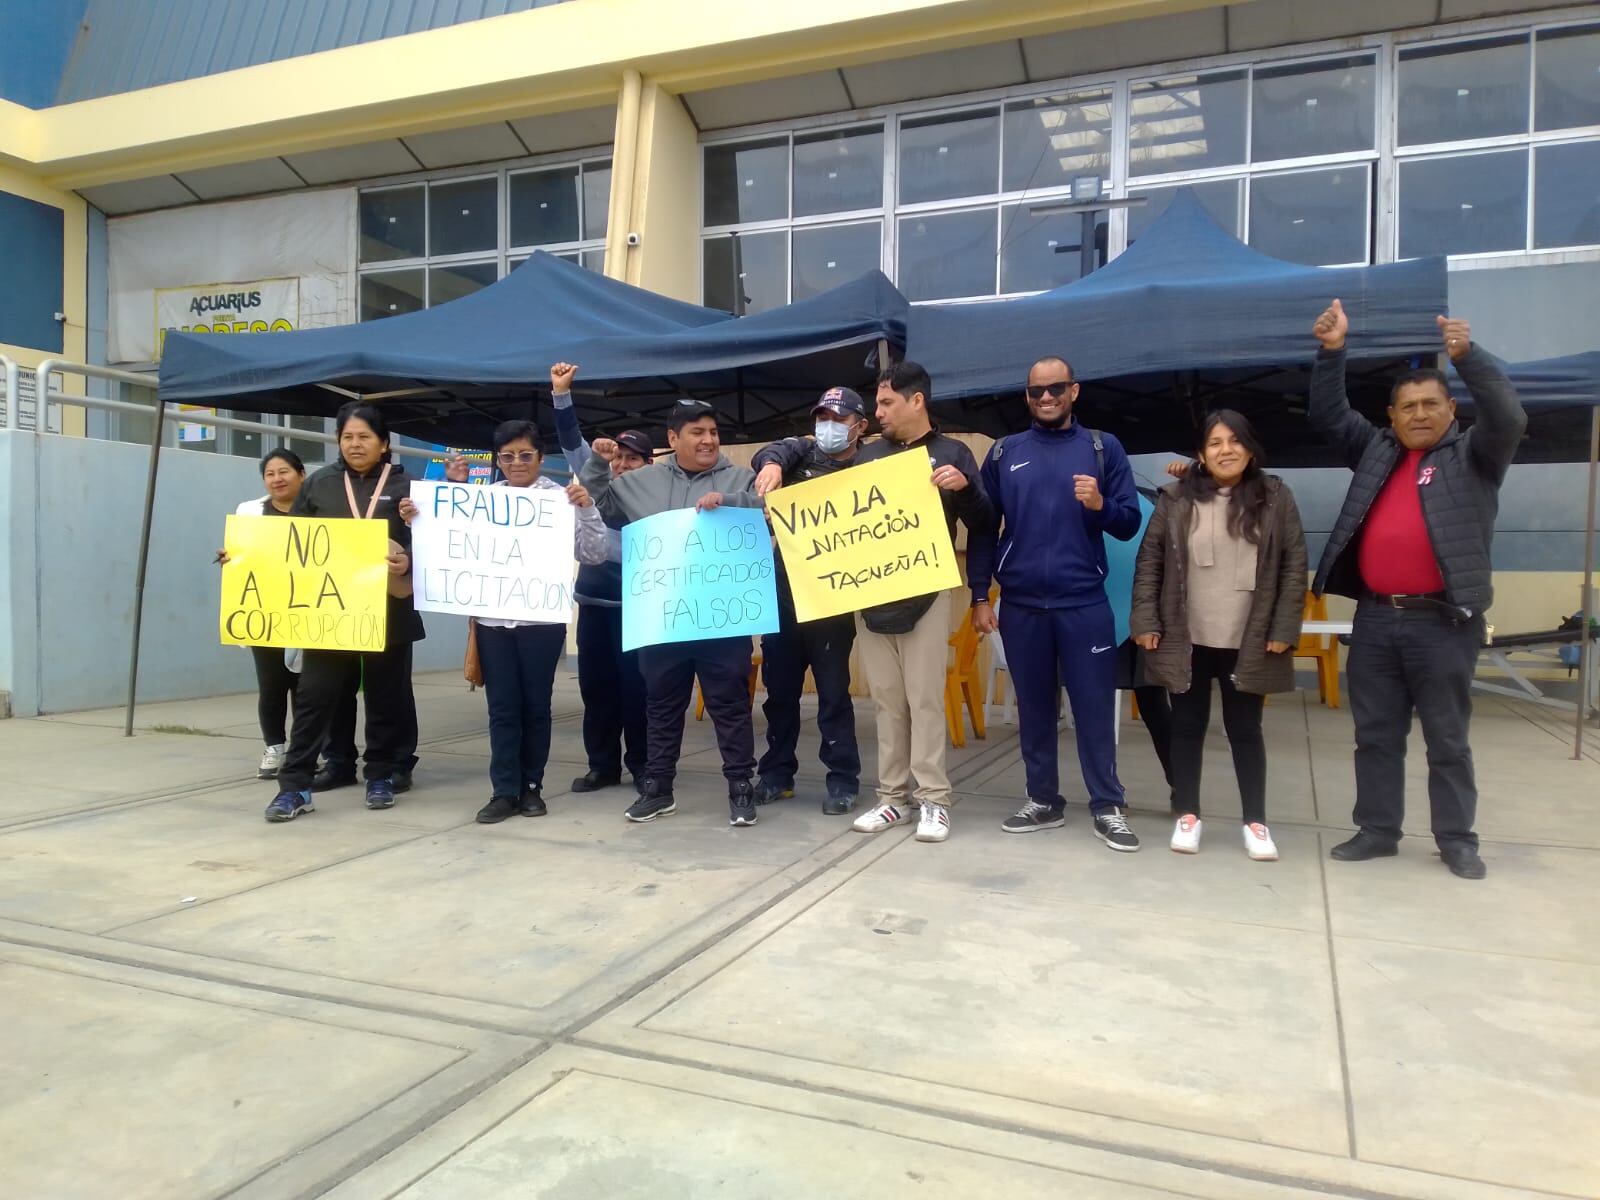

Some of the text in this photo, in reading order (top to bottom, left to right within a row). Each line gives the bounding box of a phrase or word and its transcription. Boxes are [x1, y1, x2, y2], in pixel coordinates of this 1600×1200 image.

[433, 485, 554, 528] FRAUDE
[770, 484, 886, 535] VIVA LA
[286, 520, 330, 568] NO
[448, 529, 524, 567] EN LA
[628, 522, 757, 563] NO A LOS
[240, 570, 346, 611] A LA
[423, 567, 574, 612] LICITACION
[630, 558, 771, 596] CERTIFICADOS
[226, 604, 385, 649] CORRUPCIÓN
[663, 588, 763, 631] FALSOS
